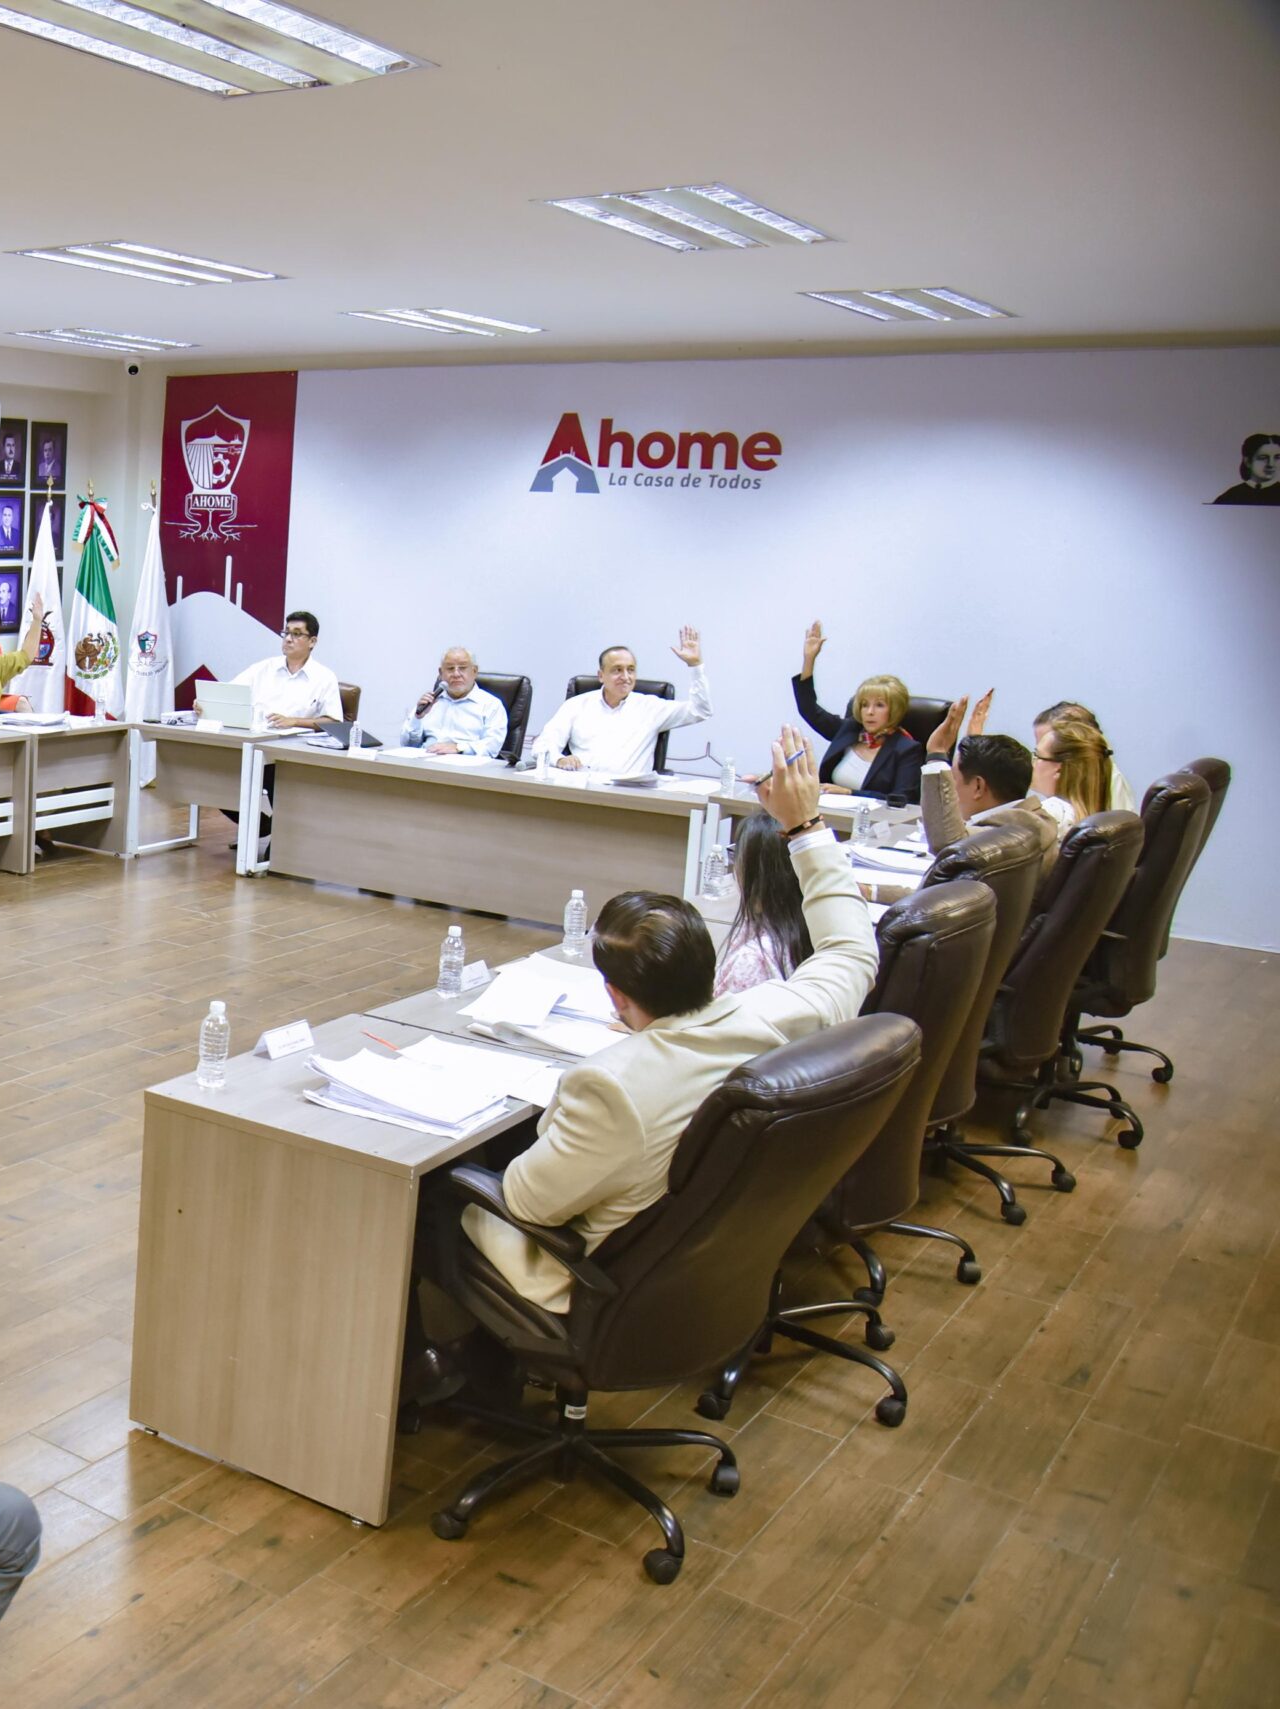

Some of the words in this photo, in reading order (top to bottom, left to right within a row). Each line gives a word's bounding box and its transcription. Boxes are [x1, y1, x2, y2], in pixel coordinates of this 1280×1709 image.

[529, 412, 782, 494] Ahome
[608, 472, 628, 487] La
[633, 472, 674, 488] Casa
[680, 473, 702, 488] de
[708, 473, 762, 490] Todos
[192, 496, 231, 507] AHOME
